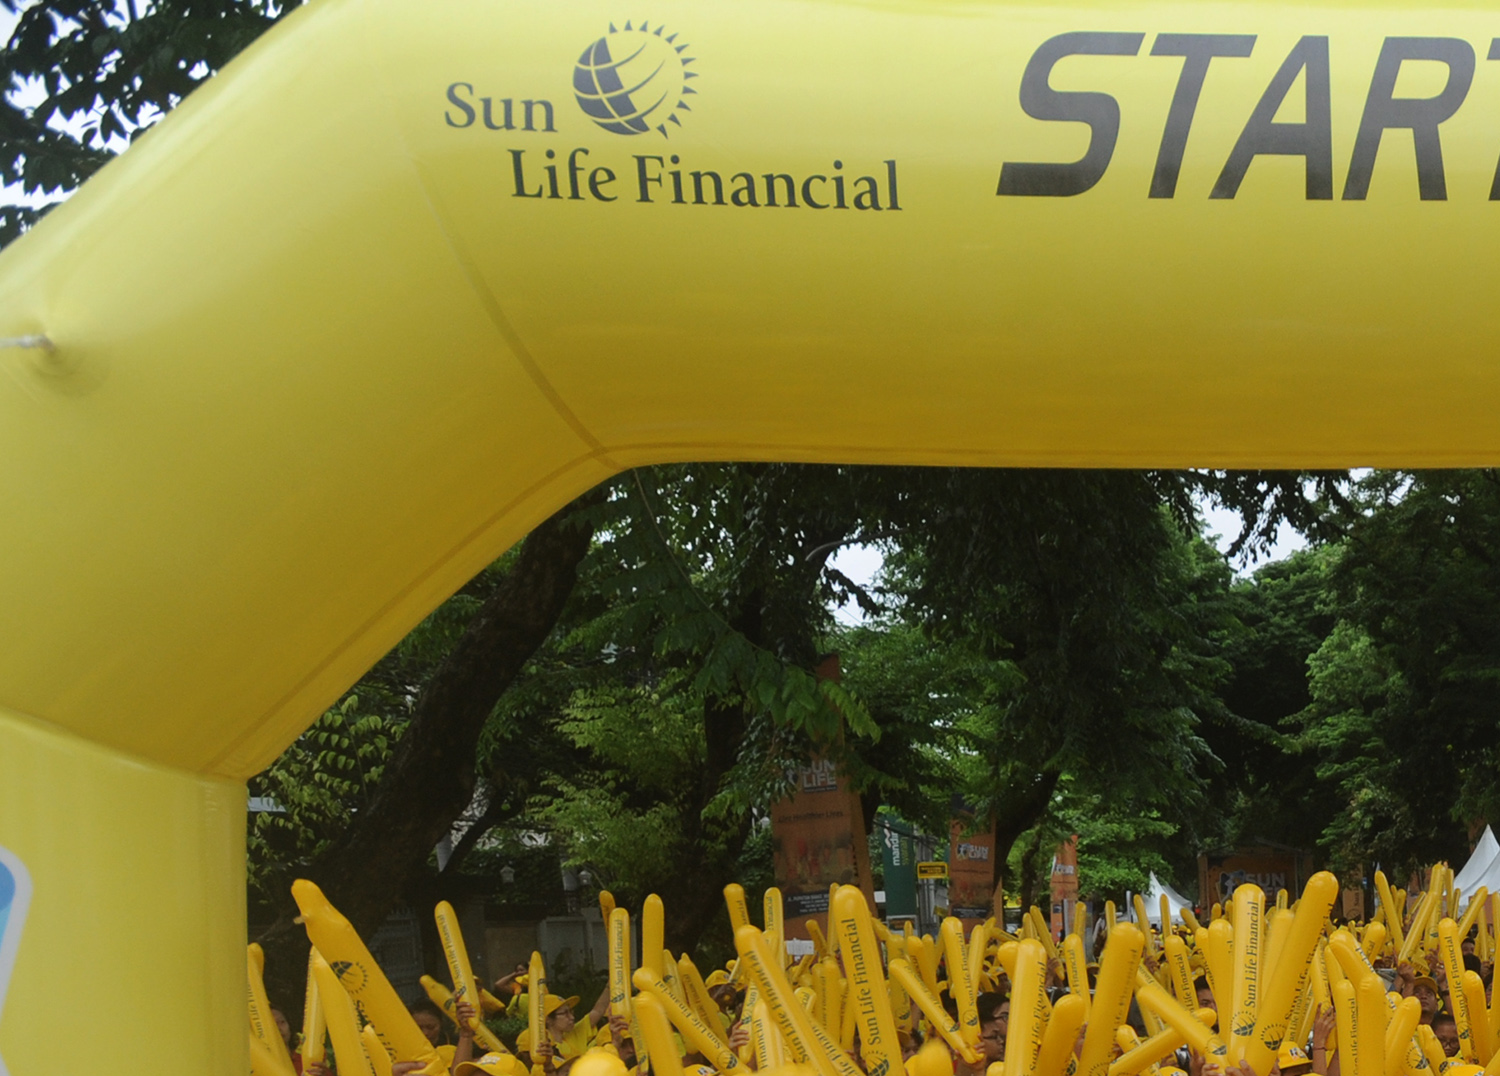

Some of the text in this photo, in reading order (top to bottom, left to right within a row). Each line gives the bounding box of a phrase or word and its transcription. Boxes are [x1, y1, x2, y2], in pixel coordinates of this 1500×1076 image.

[444, 82, 558, 133] Sun
[508, 148, 904, 212] Life Financial
[803, 771, 837, 788] LIFE
[890, 831, 900, 867] mandir
[1248, 872, 1285, 887] SUN
[1244, 901, 1260, 1009] Sun Life Financial
[1444, 936, 1461, 980] Financial
[745, 951, 811, 1064] Sun Financial
[841, 918, 882, 1046] Sun Life Financial
[753, 1018, 769, 1070] Financial
